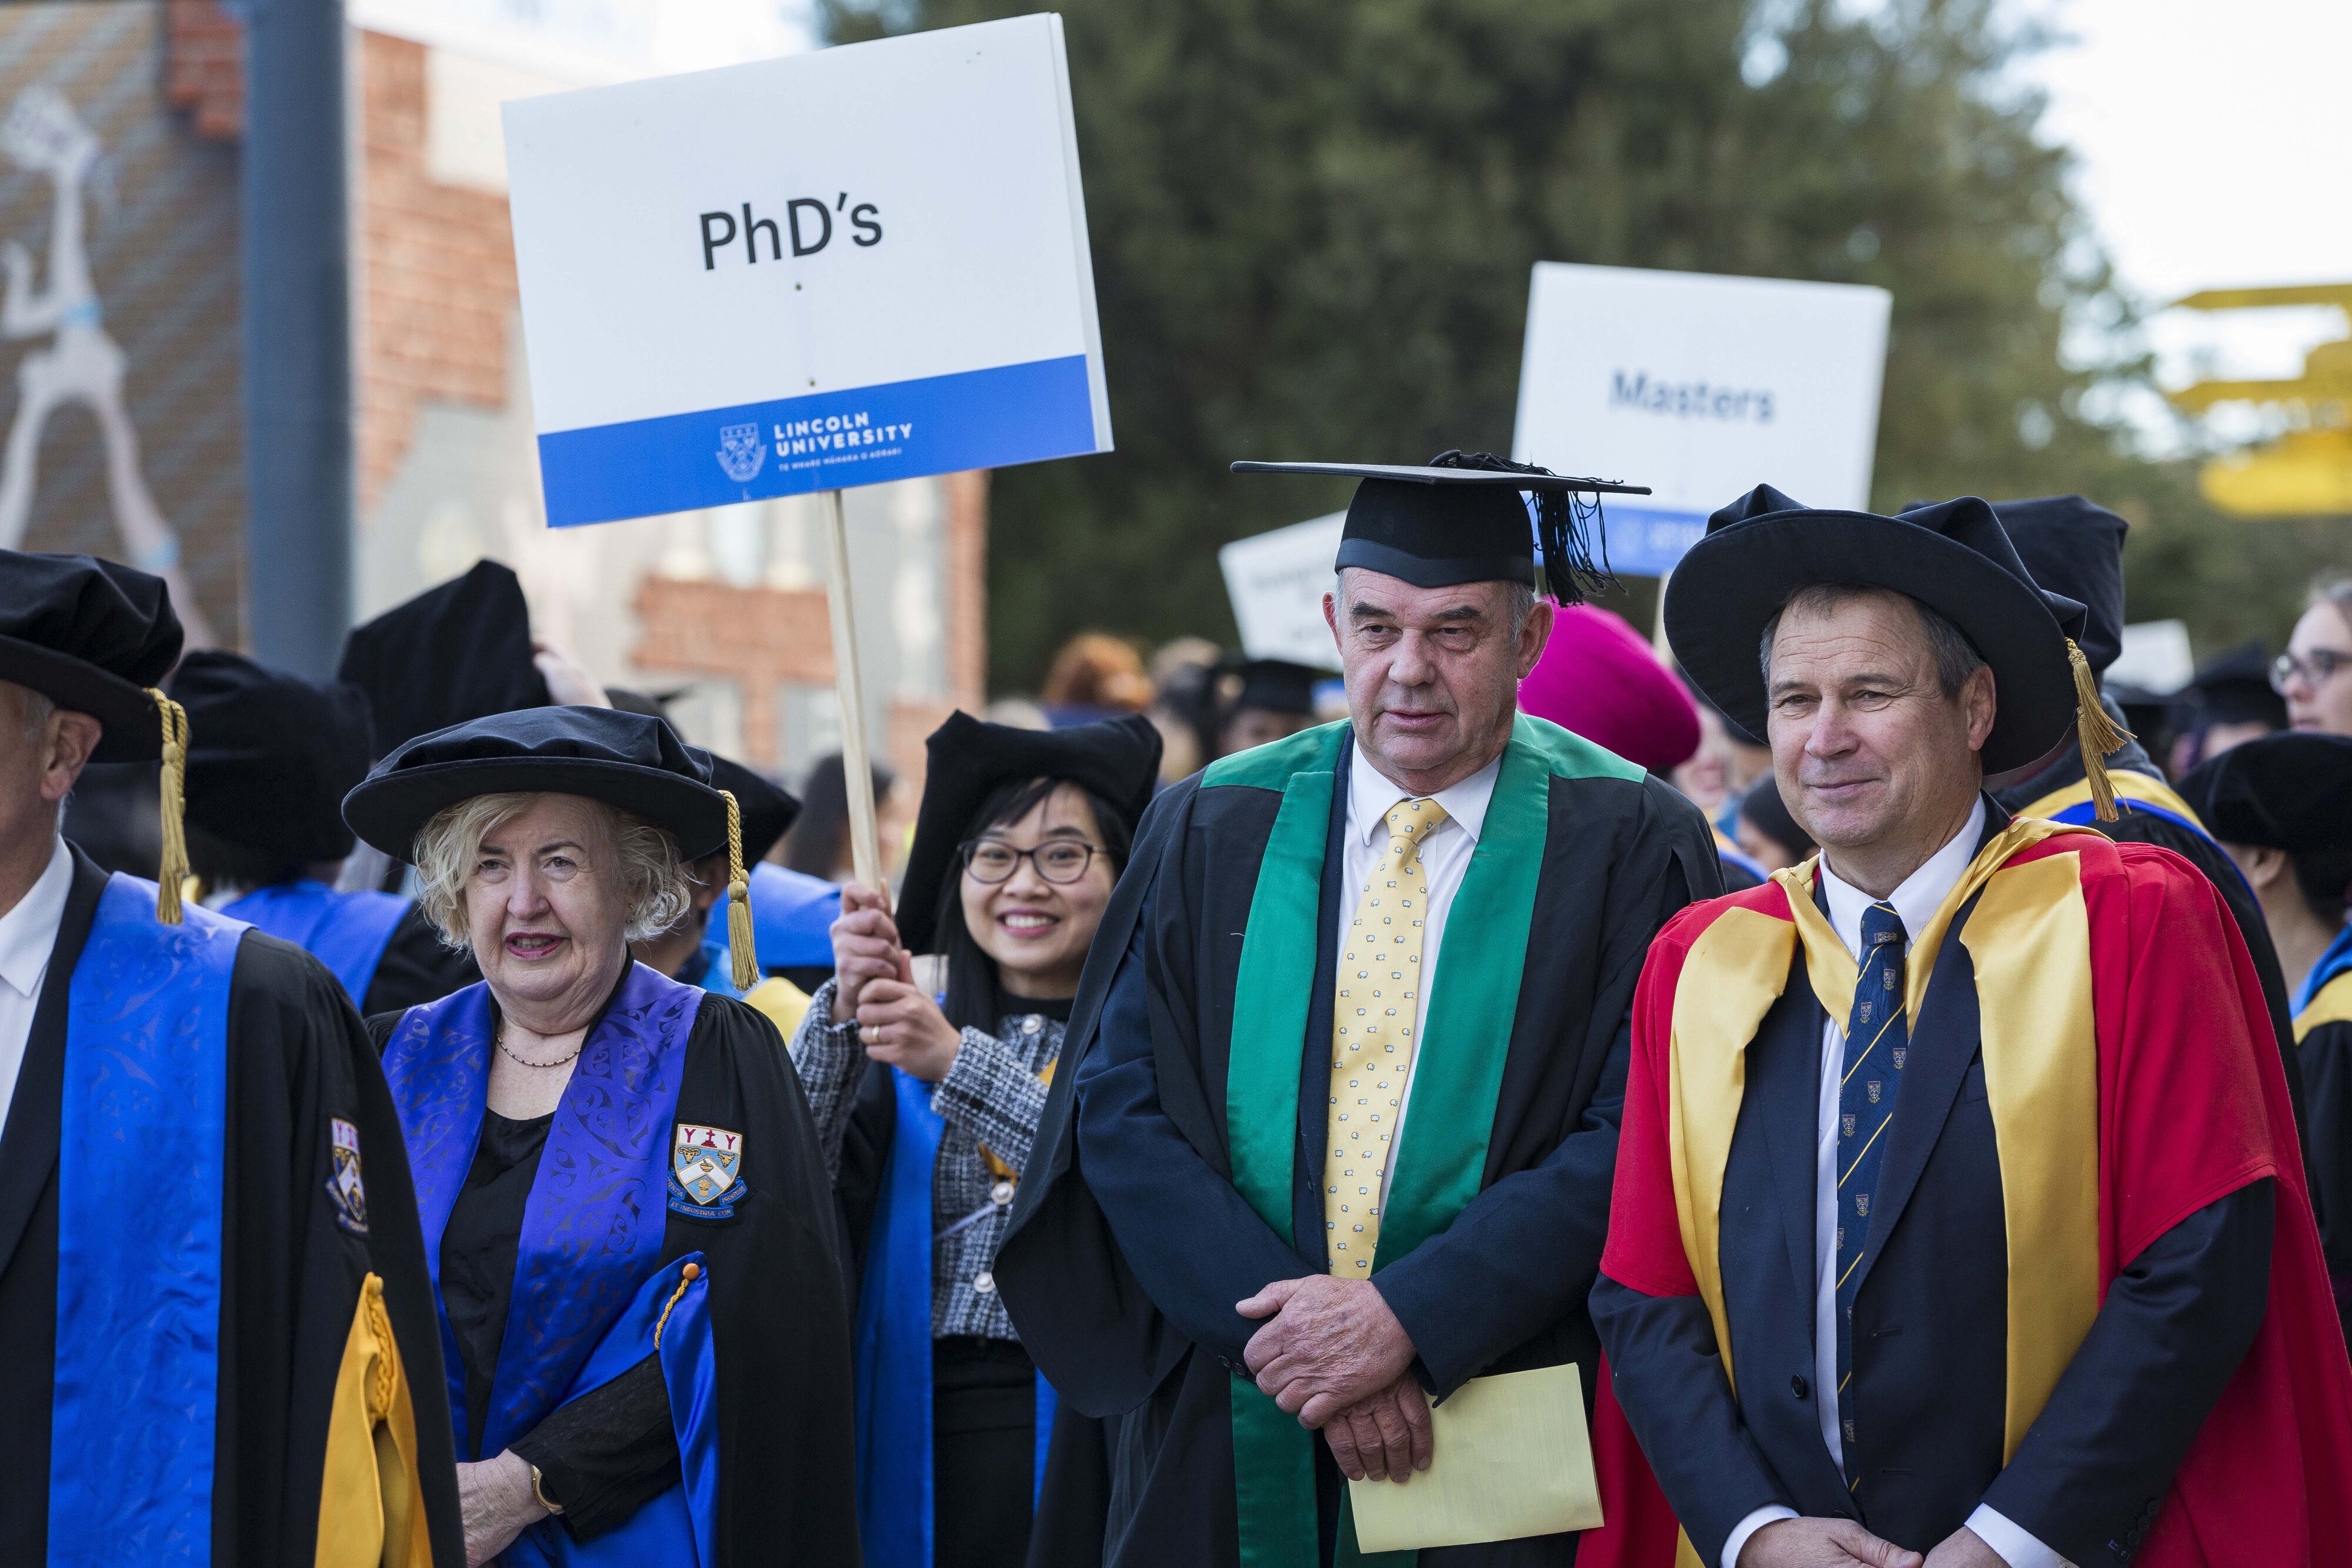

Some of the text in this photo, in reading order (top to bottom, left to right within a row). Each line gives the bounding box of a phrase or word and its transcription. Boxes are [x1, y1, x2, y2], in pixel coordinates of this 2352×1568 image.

[700, 192, 882, 270] PhD's
[1609, 369, 1776, 423] Masters
[773, 412, 869, 440] LINCOLN
[776, 423, 913, 457] UNIVERSITY
